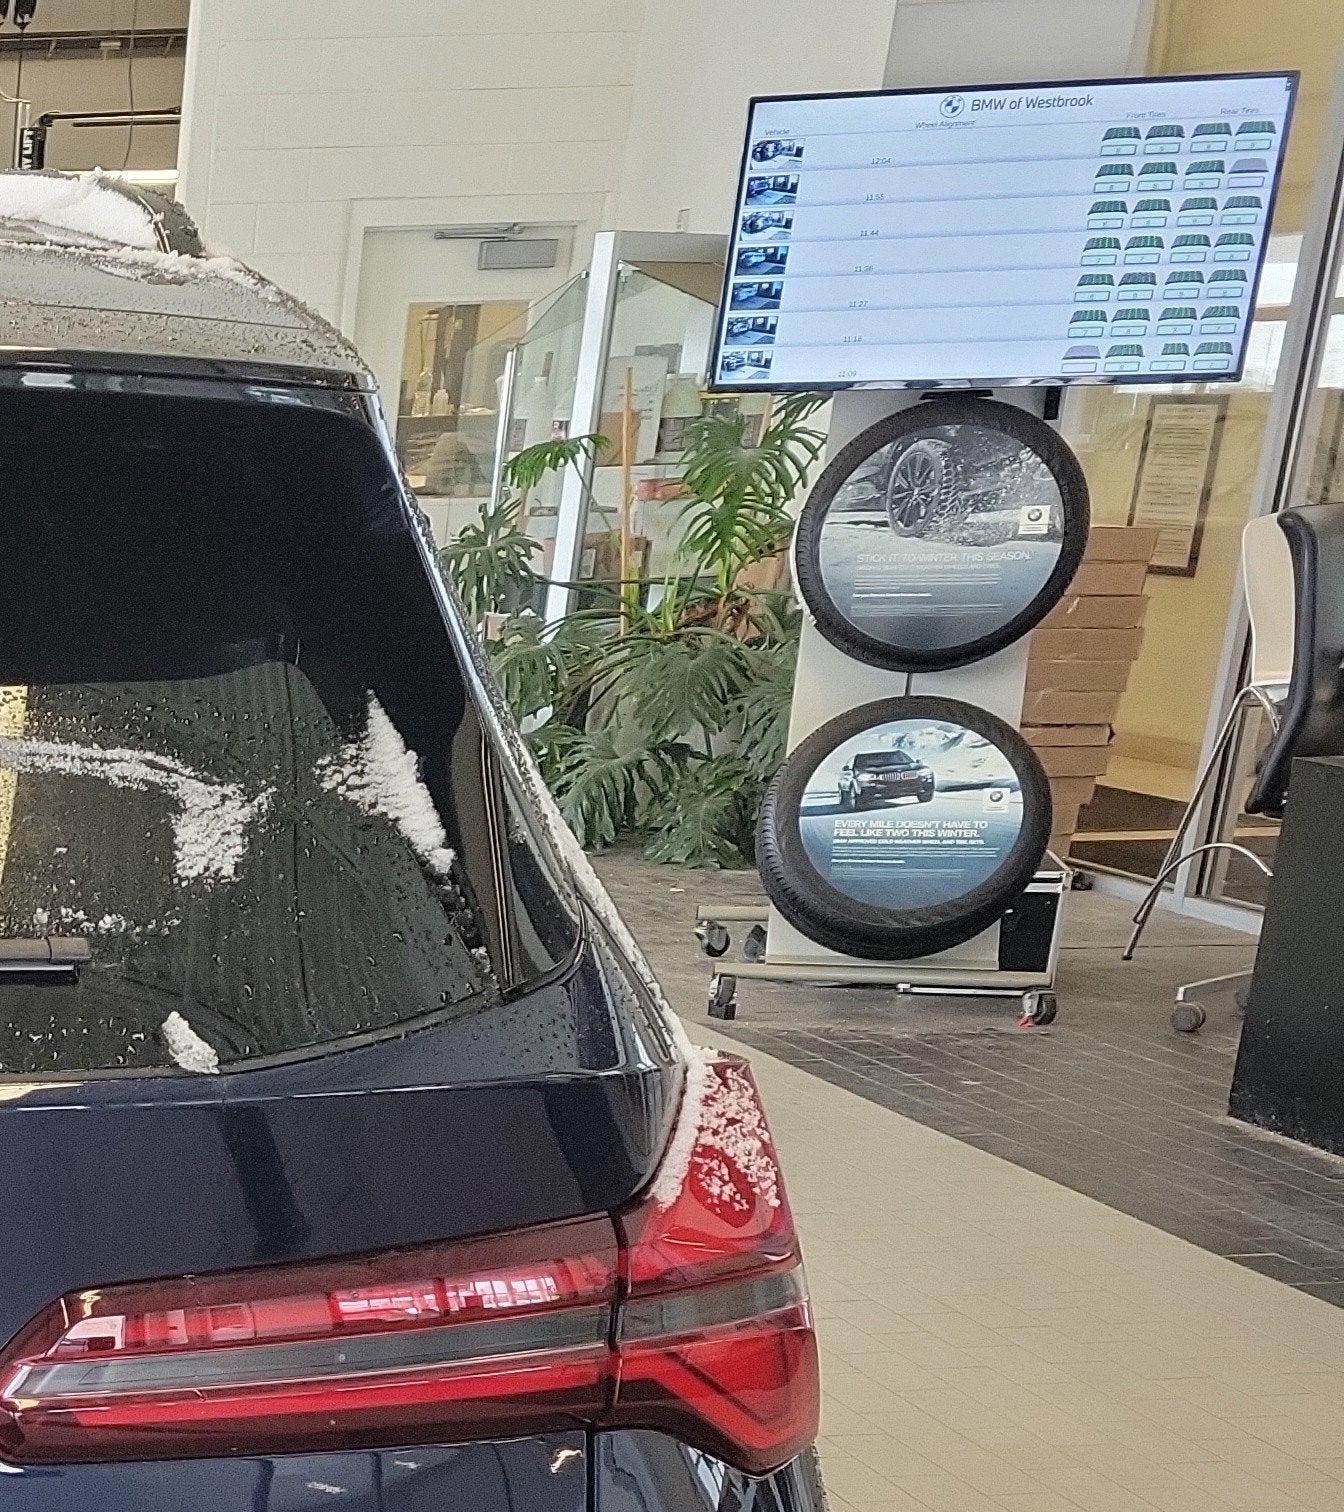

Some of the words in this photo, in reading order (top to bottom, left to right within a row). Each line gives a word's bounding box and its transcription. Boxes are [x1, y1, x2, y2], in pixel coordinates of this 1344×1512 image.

[971, 97, 1007, 112] BMW
[1009, 96, 1022, 110] of
[1025, 94, 1094, 109] Westbrook
[915, 121, 938, 129] Wheel
[939, 120, 975, 129] Alignment
[22, 129, 34, 155] LIFT
[857, 553, 885, 563] STICK
[902, 553, 917, 562] TO
[918, 553, 958, 562] WINTER
[962, 552, 984, 562] THIS
[834, 819, 868, 829] EVERY
[869, 820, 894, 829] MILE
[896, 820, 940, 829] DOESN'T
[942, 821, 971, 829] HAVE
[973, 821, 989, 829] TO
[833, 829, 860, 837] FEEL
[860, 829, 883, 837] LIKE
[885, 829, 910, 837] TWO
[911, 829, 936, 838] THIS
[937, 829, 980, 838] WINTER.
